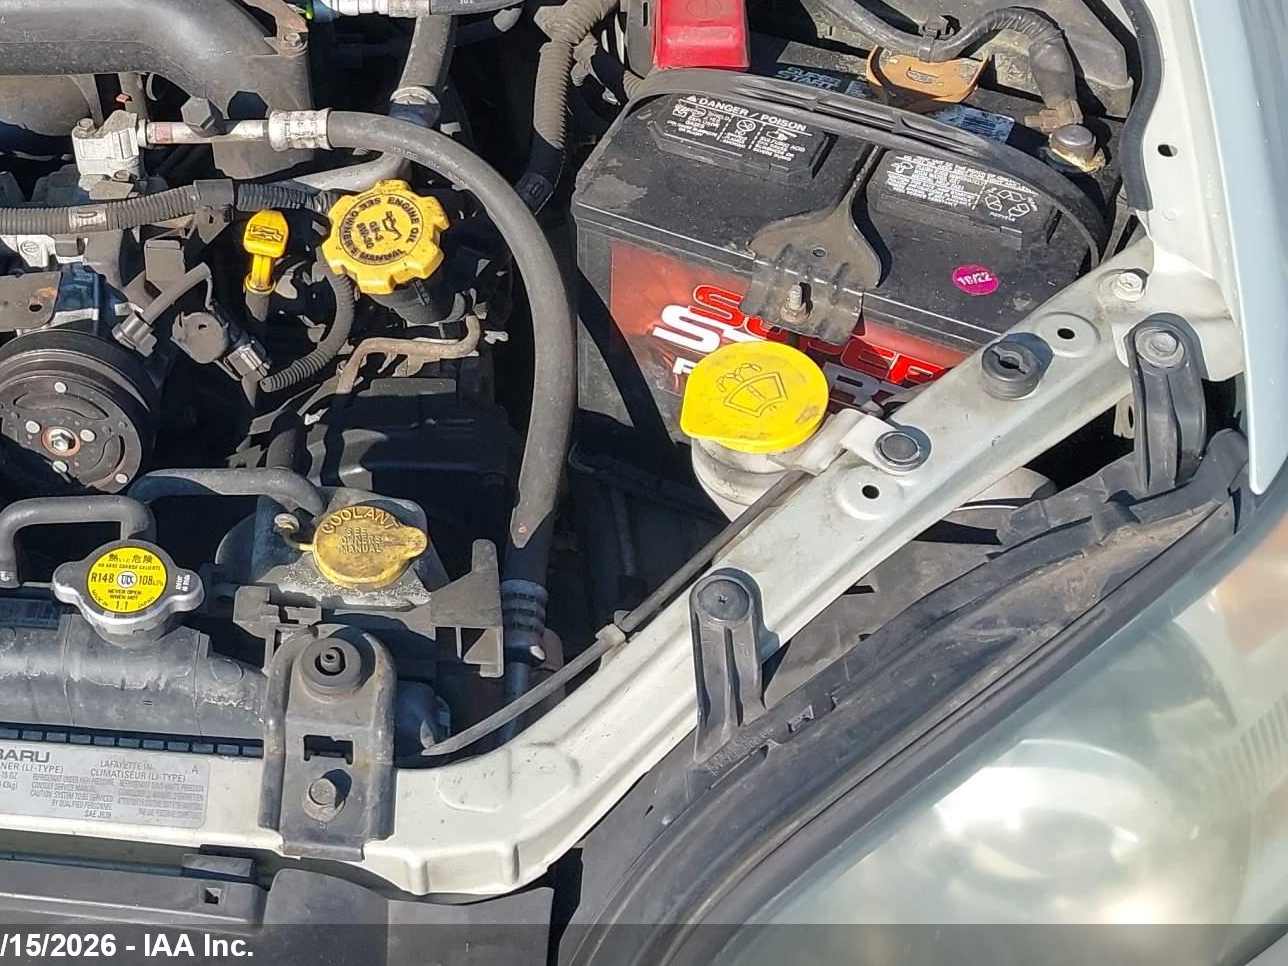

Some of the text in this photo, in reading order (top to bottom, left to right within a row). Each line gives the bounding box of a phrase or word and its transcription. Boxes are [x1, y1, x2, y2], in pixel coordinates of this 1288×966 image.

[698, 97, 749, 117] DANGER
[760, 114, 807, 132] POISON
[359, 197, 381, 211] SEE
[386, 196, 420, 243] ENGINE OIL
[359, 248, 407, 261] MANUAL
[322, 507, 400, 534] COOLANT
[347, 527, 368, 536] SEE
[340, 543, 383, 554] MANUAL
[91, 572, 114, 584] R148
[21, 763, 63, 775] (LI-TYPE)
[100, 760, 142, 771] LAFAYETTE
[192, 765, 199, 774] A
[90, 769, 146, 780] CLIMATISEUR
